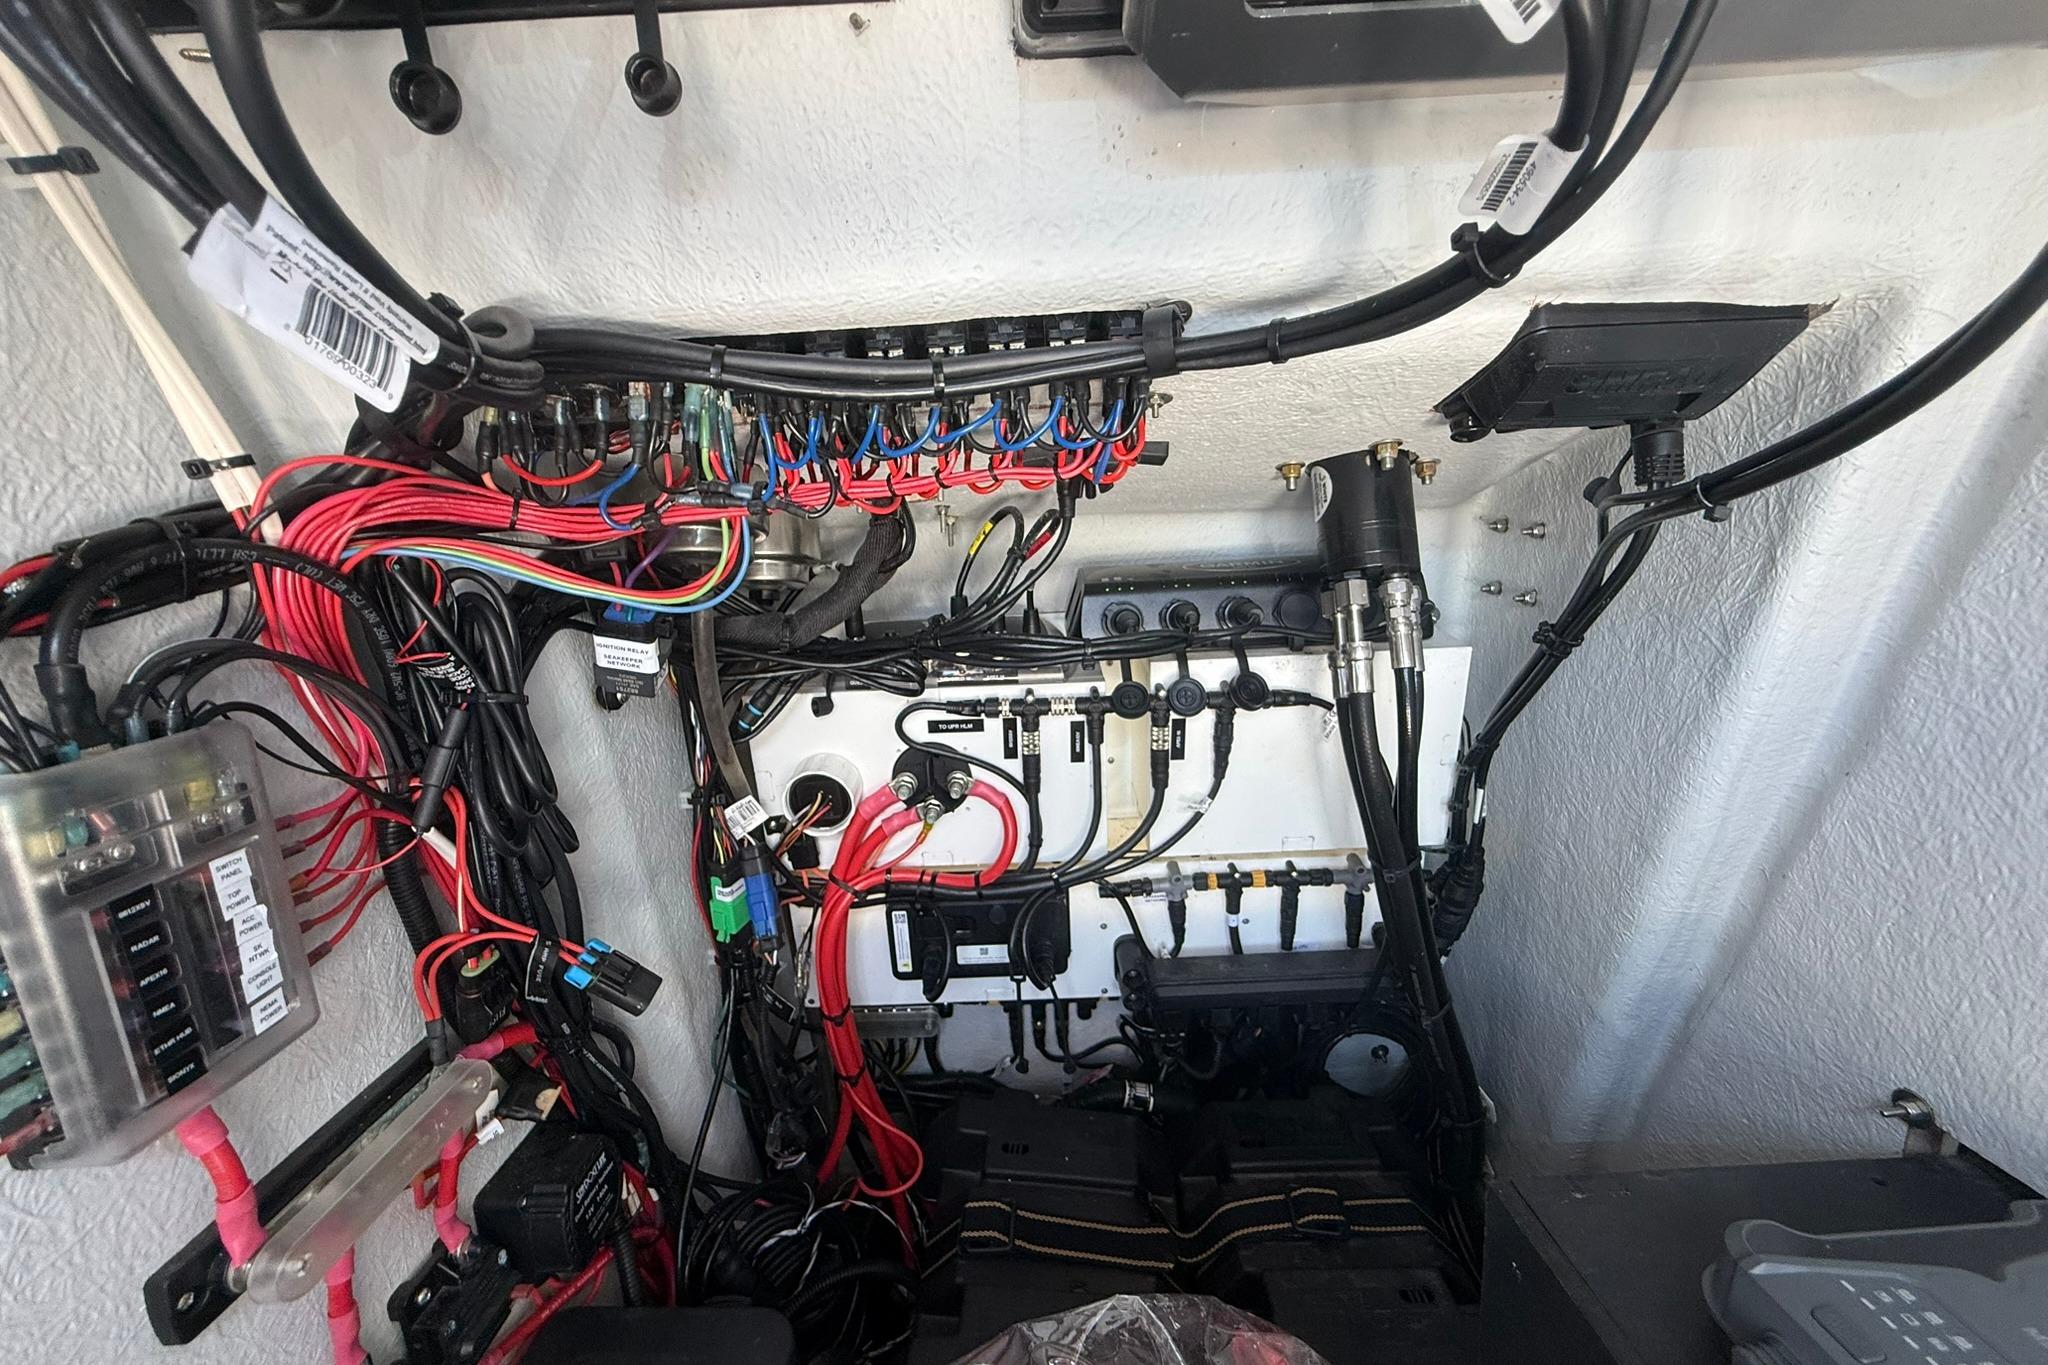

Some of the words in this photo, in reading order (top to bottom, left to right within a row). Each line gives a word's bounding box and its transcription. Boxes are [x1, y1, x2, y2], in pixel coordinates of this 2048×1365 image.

[596, 643, 626, 652] IGNITION
[603, 654, 643, 664] SEAKEEPER
[607, 660, 641, 669] NETWORK
[215, 856, 243, 873] SWITCH
[220, 867, 243, 882] PANEL
[227, 888, 242, 900] TOP
[226, 894, 251, 912] POWER
[241, 914, 255, 926] ACC
[239, 921, 263, 938] POWER
[130, 935, 160, 953] RADAR
[253, 943, 263, 953] SK
[248, 947, 270, 964] NTWK
[247, 961, 277, 984] CONSOLE
[536, 964, 544, 982] FUSE
[256, 975, 273, 990] LIGHT
[259, 998, 278, 1014] NEMA
[260, 1005, 283, 1025] POWER
